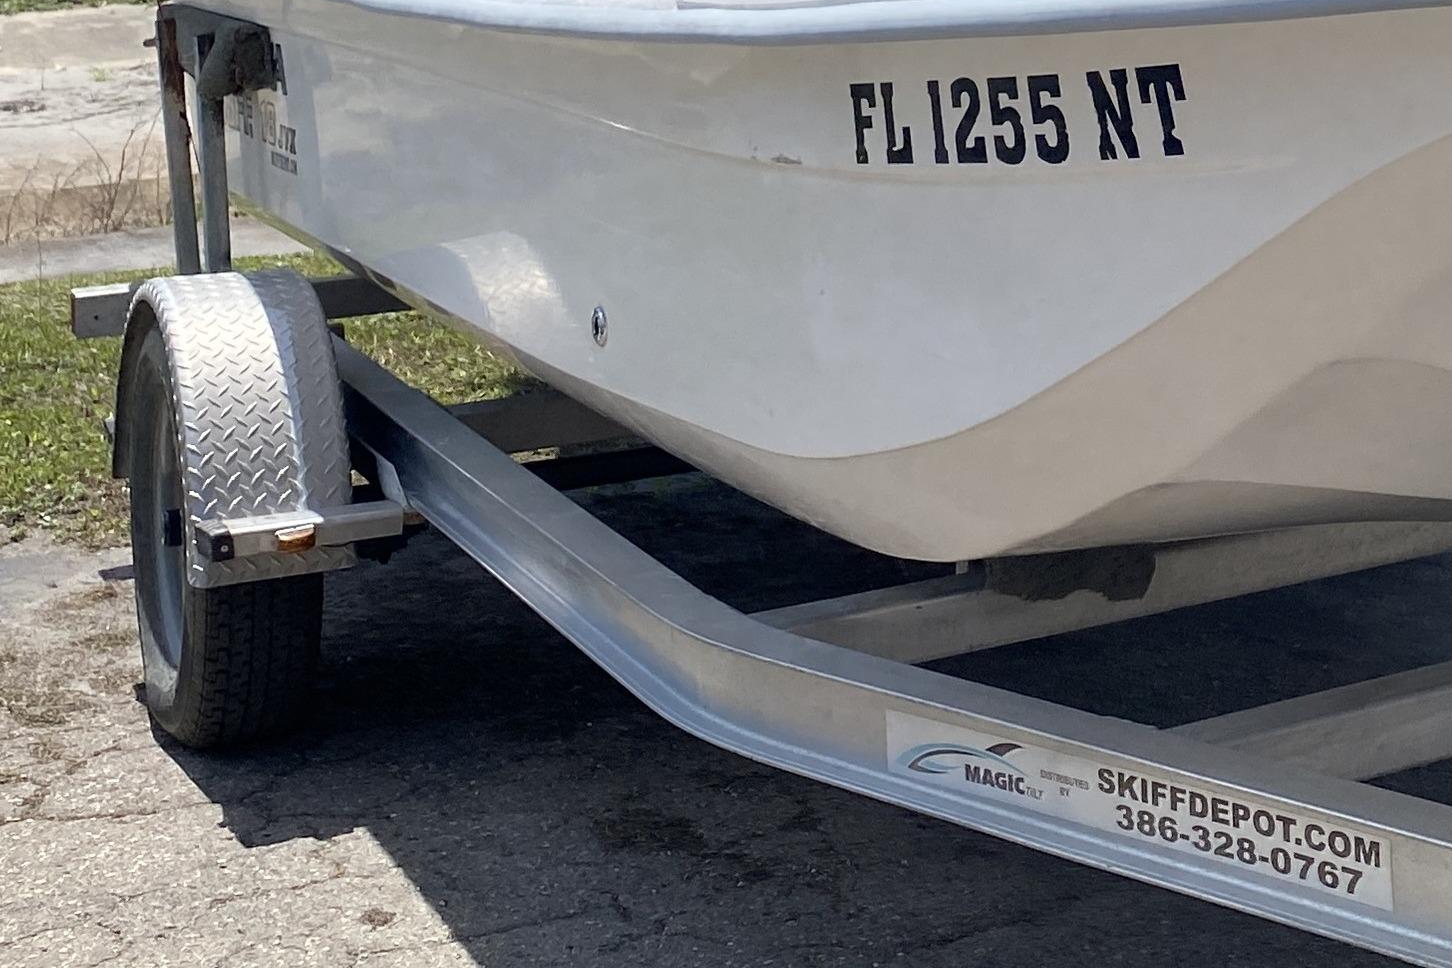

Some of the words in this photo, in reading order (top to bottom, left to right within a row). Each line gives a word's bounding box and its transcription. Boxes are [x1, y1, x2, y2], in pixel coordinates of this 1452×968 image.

[849, 82, 914, 164] FL
[926, 74, 1071, 165] 1255
[1086, 64, 1187, 161] NT
[964, 763, 1026, 795] MAGIC
[1097, 768, 1381, 868] SKIFFDEPOT.COM
[1115, 804, 1363, 895] 386-328-0767
